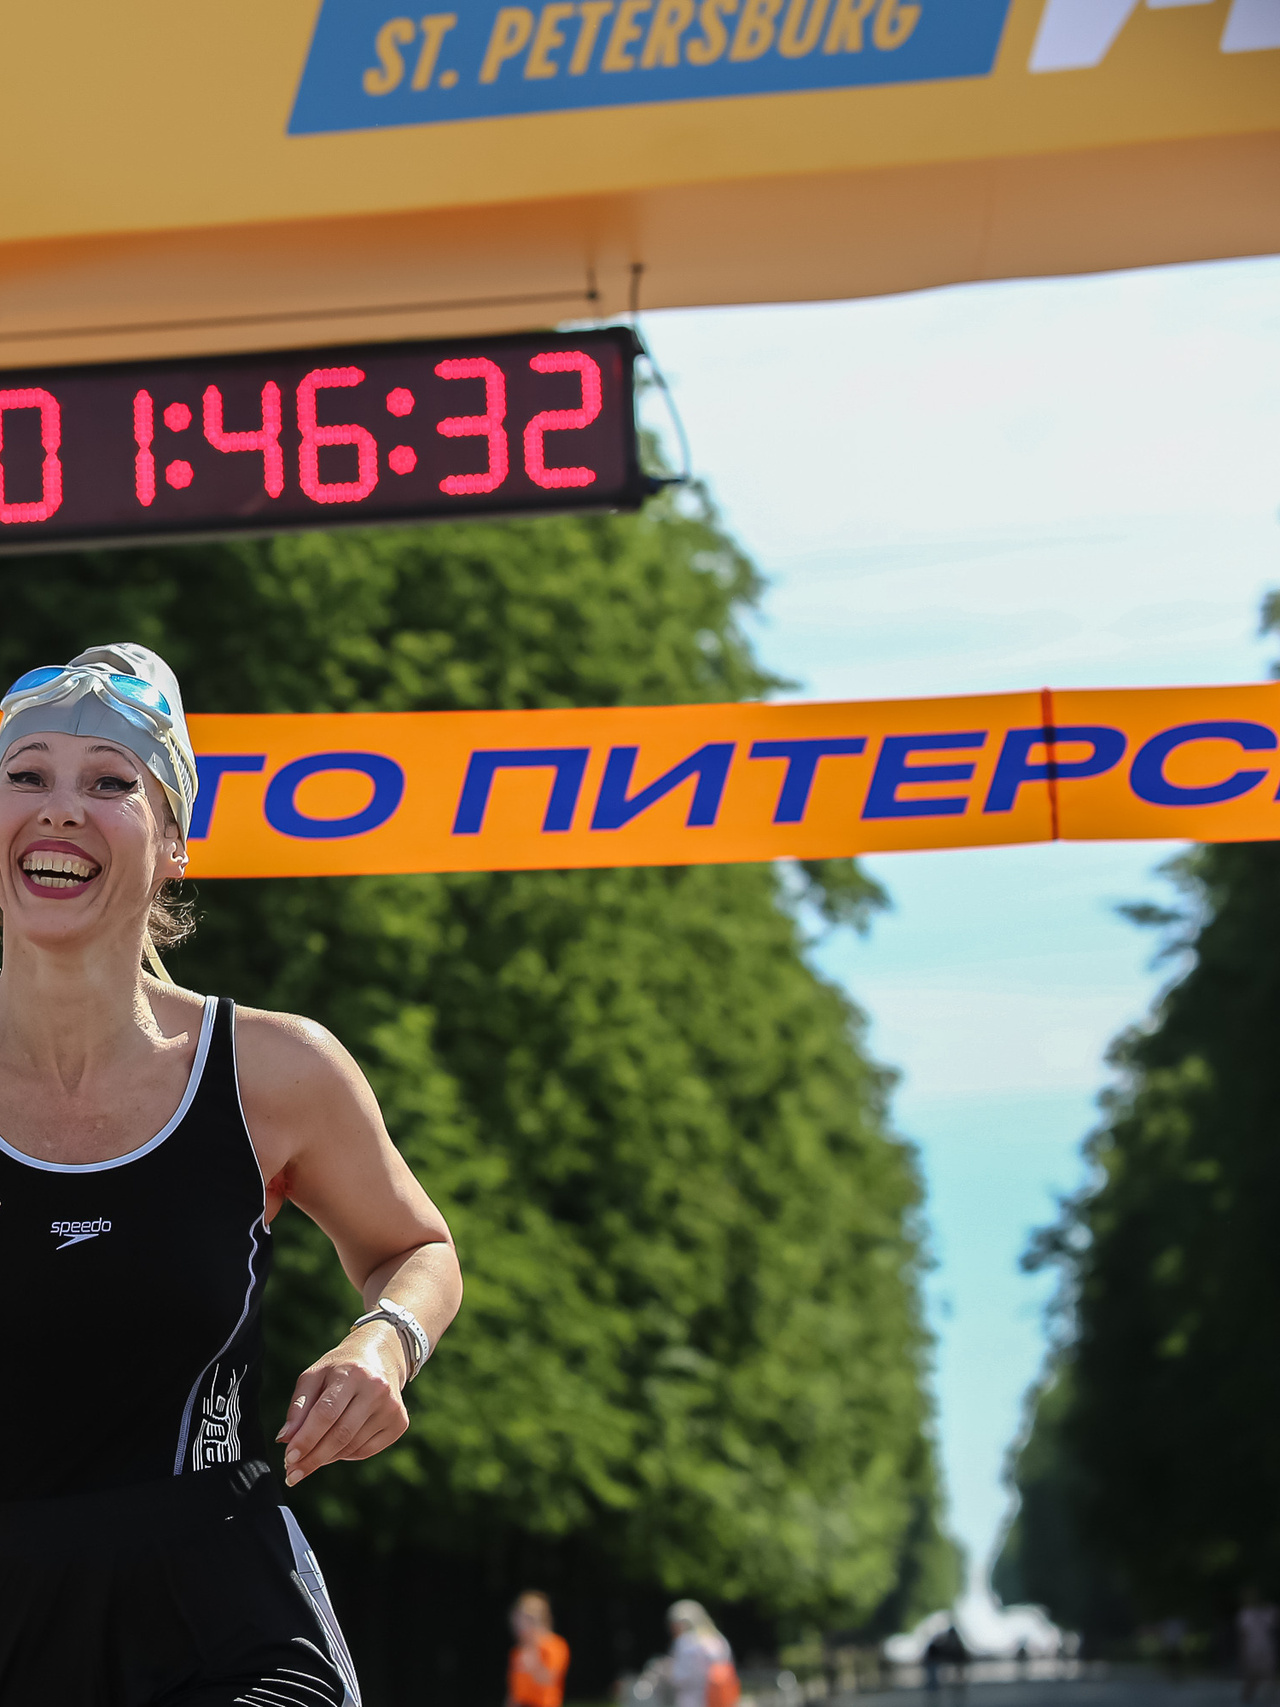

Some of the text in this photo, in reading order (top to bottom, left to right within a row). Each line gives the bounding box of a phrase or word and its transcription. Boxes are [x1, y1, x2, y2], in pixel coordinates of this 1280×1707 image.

[362, 0, 922, 97] ST. PETERSBURG
[452, 719, 1280, 836] ПИТЕРС
[50, 1217, 112, 1237] speedo
